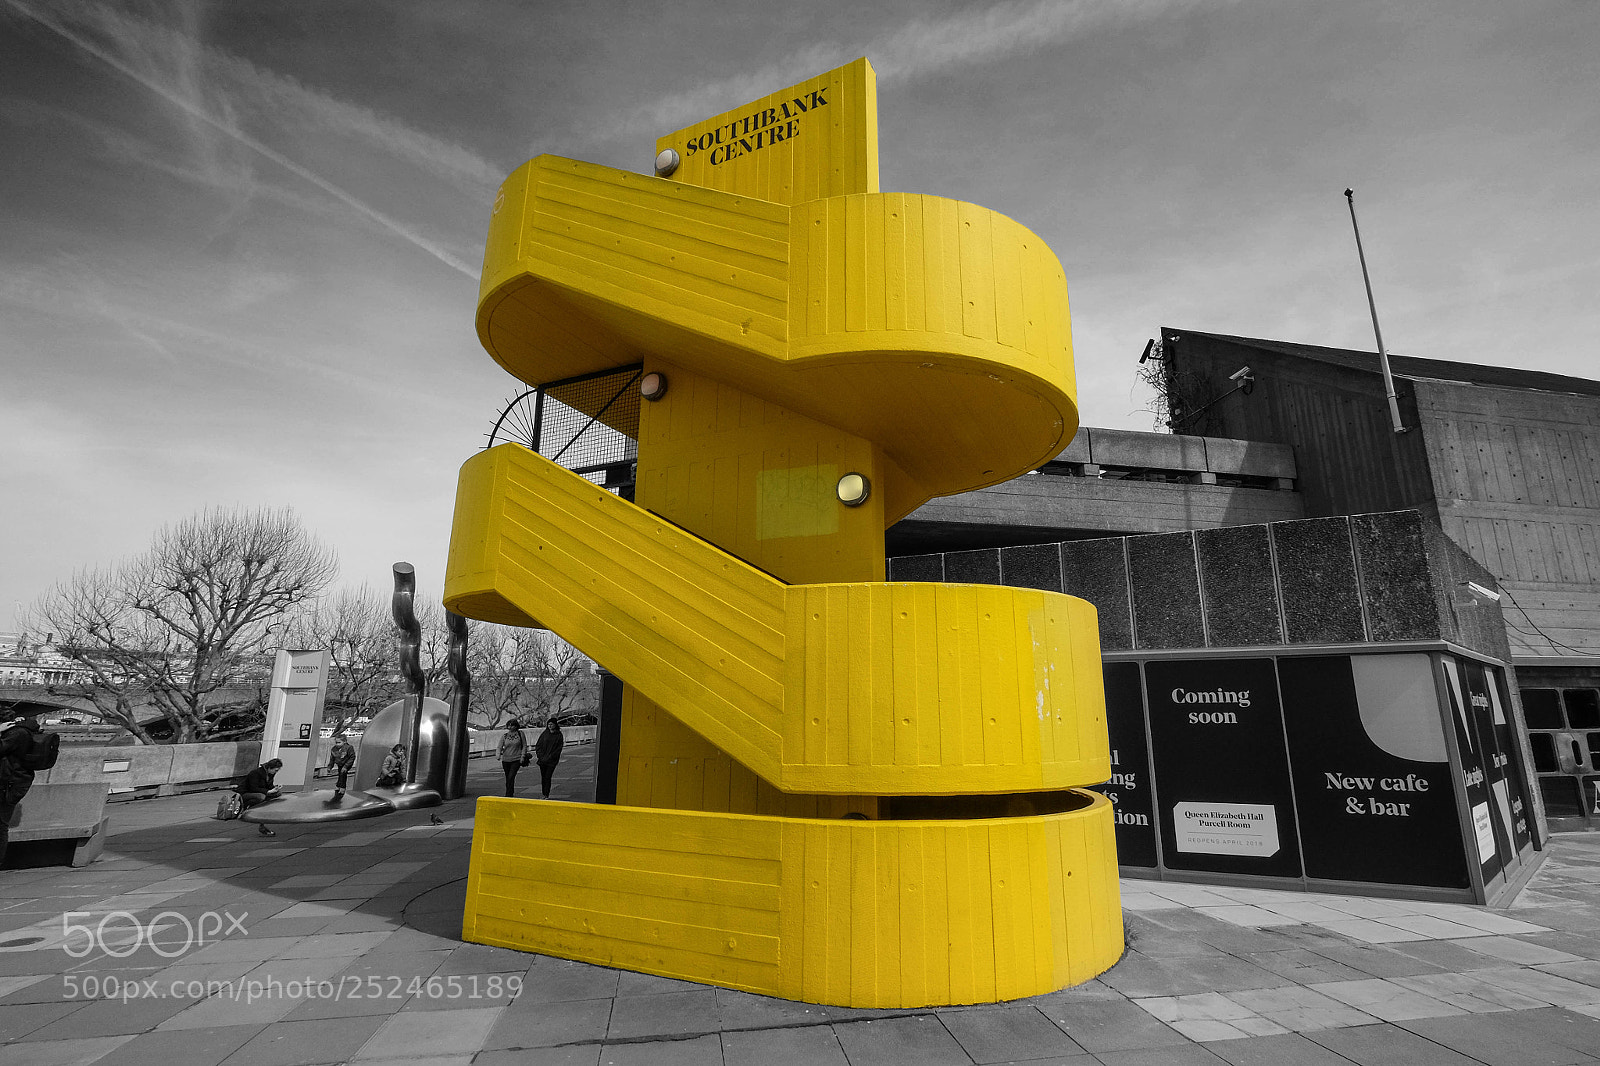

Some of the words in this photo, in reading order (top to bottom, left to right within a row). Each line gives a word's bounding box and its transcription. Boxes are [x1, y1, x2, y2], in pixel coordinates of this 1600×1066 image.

[686, 87, 828, 157] SOUTHBANK
[710, 118, 800, 166] CENTRE
[1171, 687, 1251, 708] Coming
[1188, 712, 1238, 724] soon
[1324, 772, 1375, 790] New
[1380, 773, 1429, 792] cafe
[1184, 810, 1209, 819] Queen
[1210, 811, 1246, 820] Elizabeth
[1247, 813, 1264, 821] Hall
[1345, 796, 1366, 815] &
[1368, 797, 1411, 817] bar
[1199, 819, 1226, 828] Purcell
[1227, 821, 1251, 829] Room
[1187, 837, 1220, 845] REOPENS
